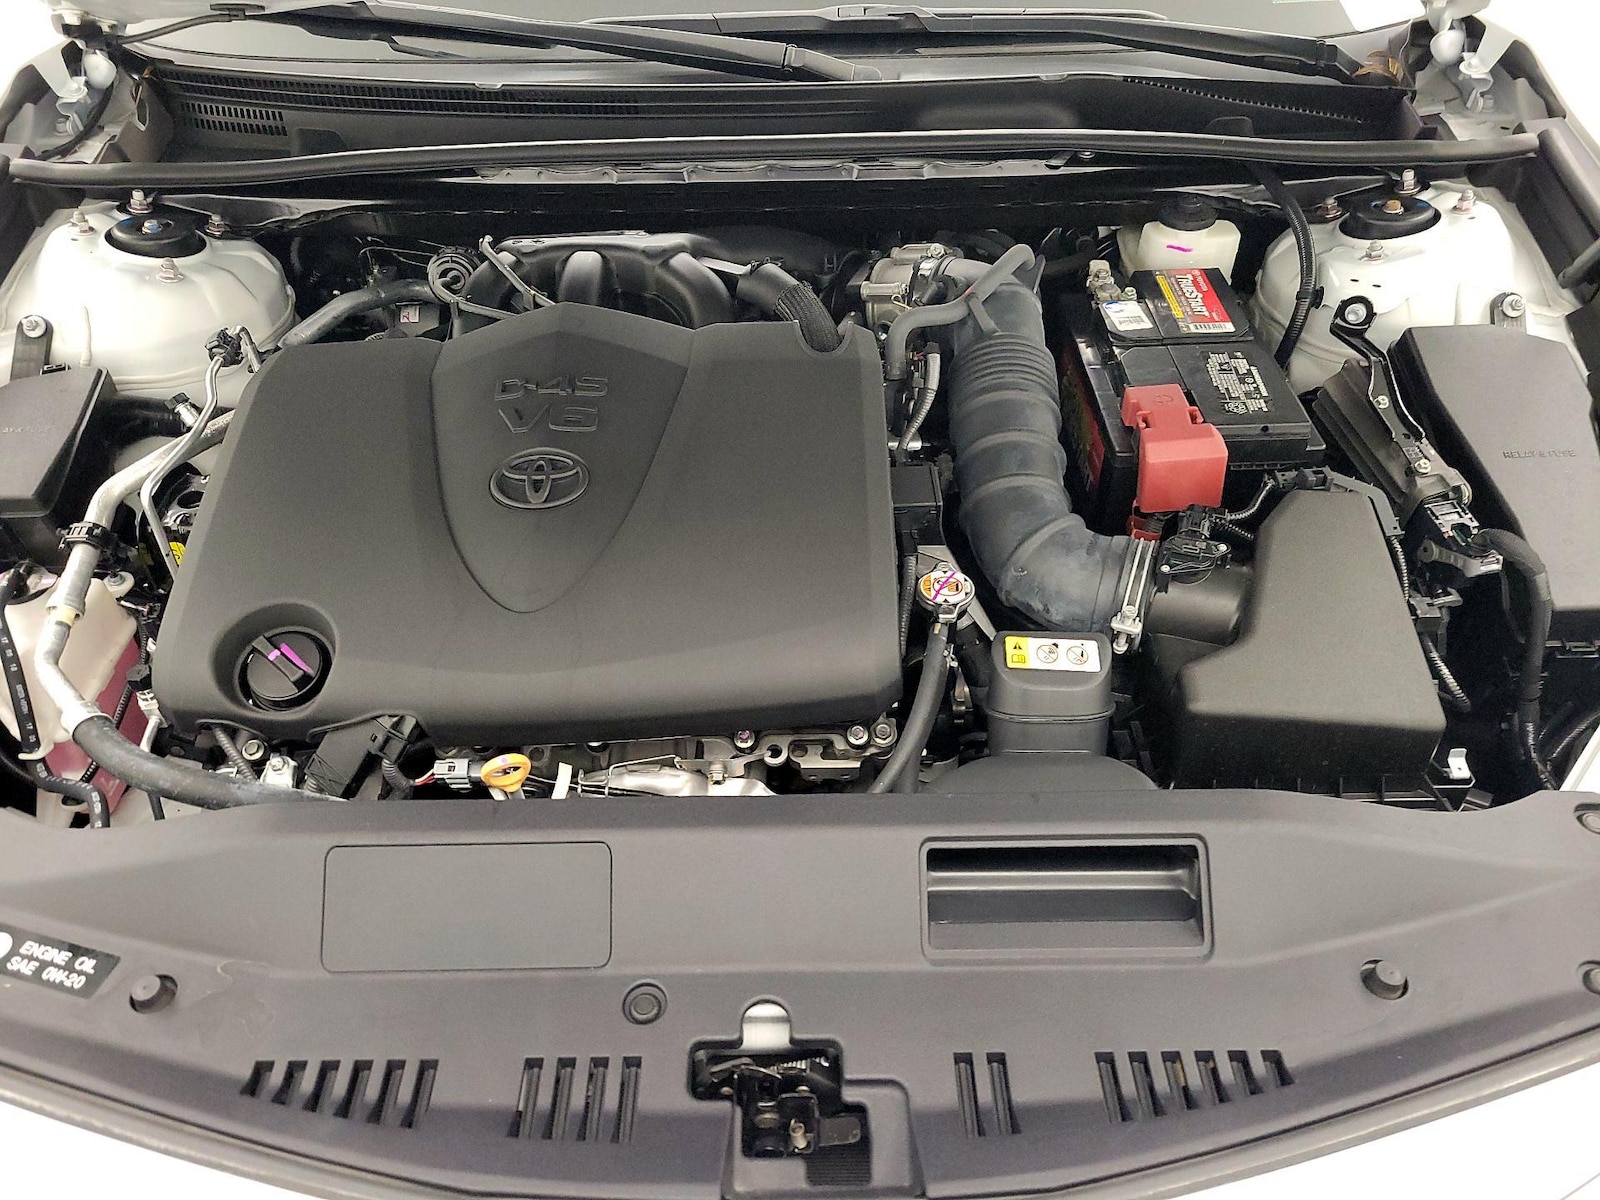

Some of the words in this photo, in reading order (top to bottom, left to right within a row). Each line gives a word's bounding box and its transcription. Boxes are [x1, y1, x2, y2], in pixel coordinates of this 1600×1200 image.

[1175, 273, 1211, 319] TRUESTART
[495, 377, 608, 401] D-4S
[498, 402, 599, 433] V6
[1502, 449, 1537, 459] RELAY
[1547, 449, 1577, 458] FUSE
[6, 955, 40, 976] SAE
[41, 966, 87, 989] 0W-20
[19, 940, 73, 966] ENGINE
[74, 956, 97, 974] OIL
